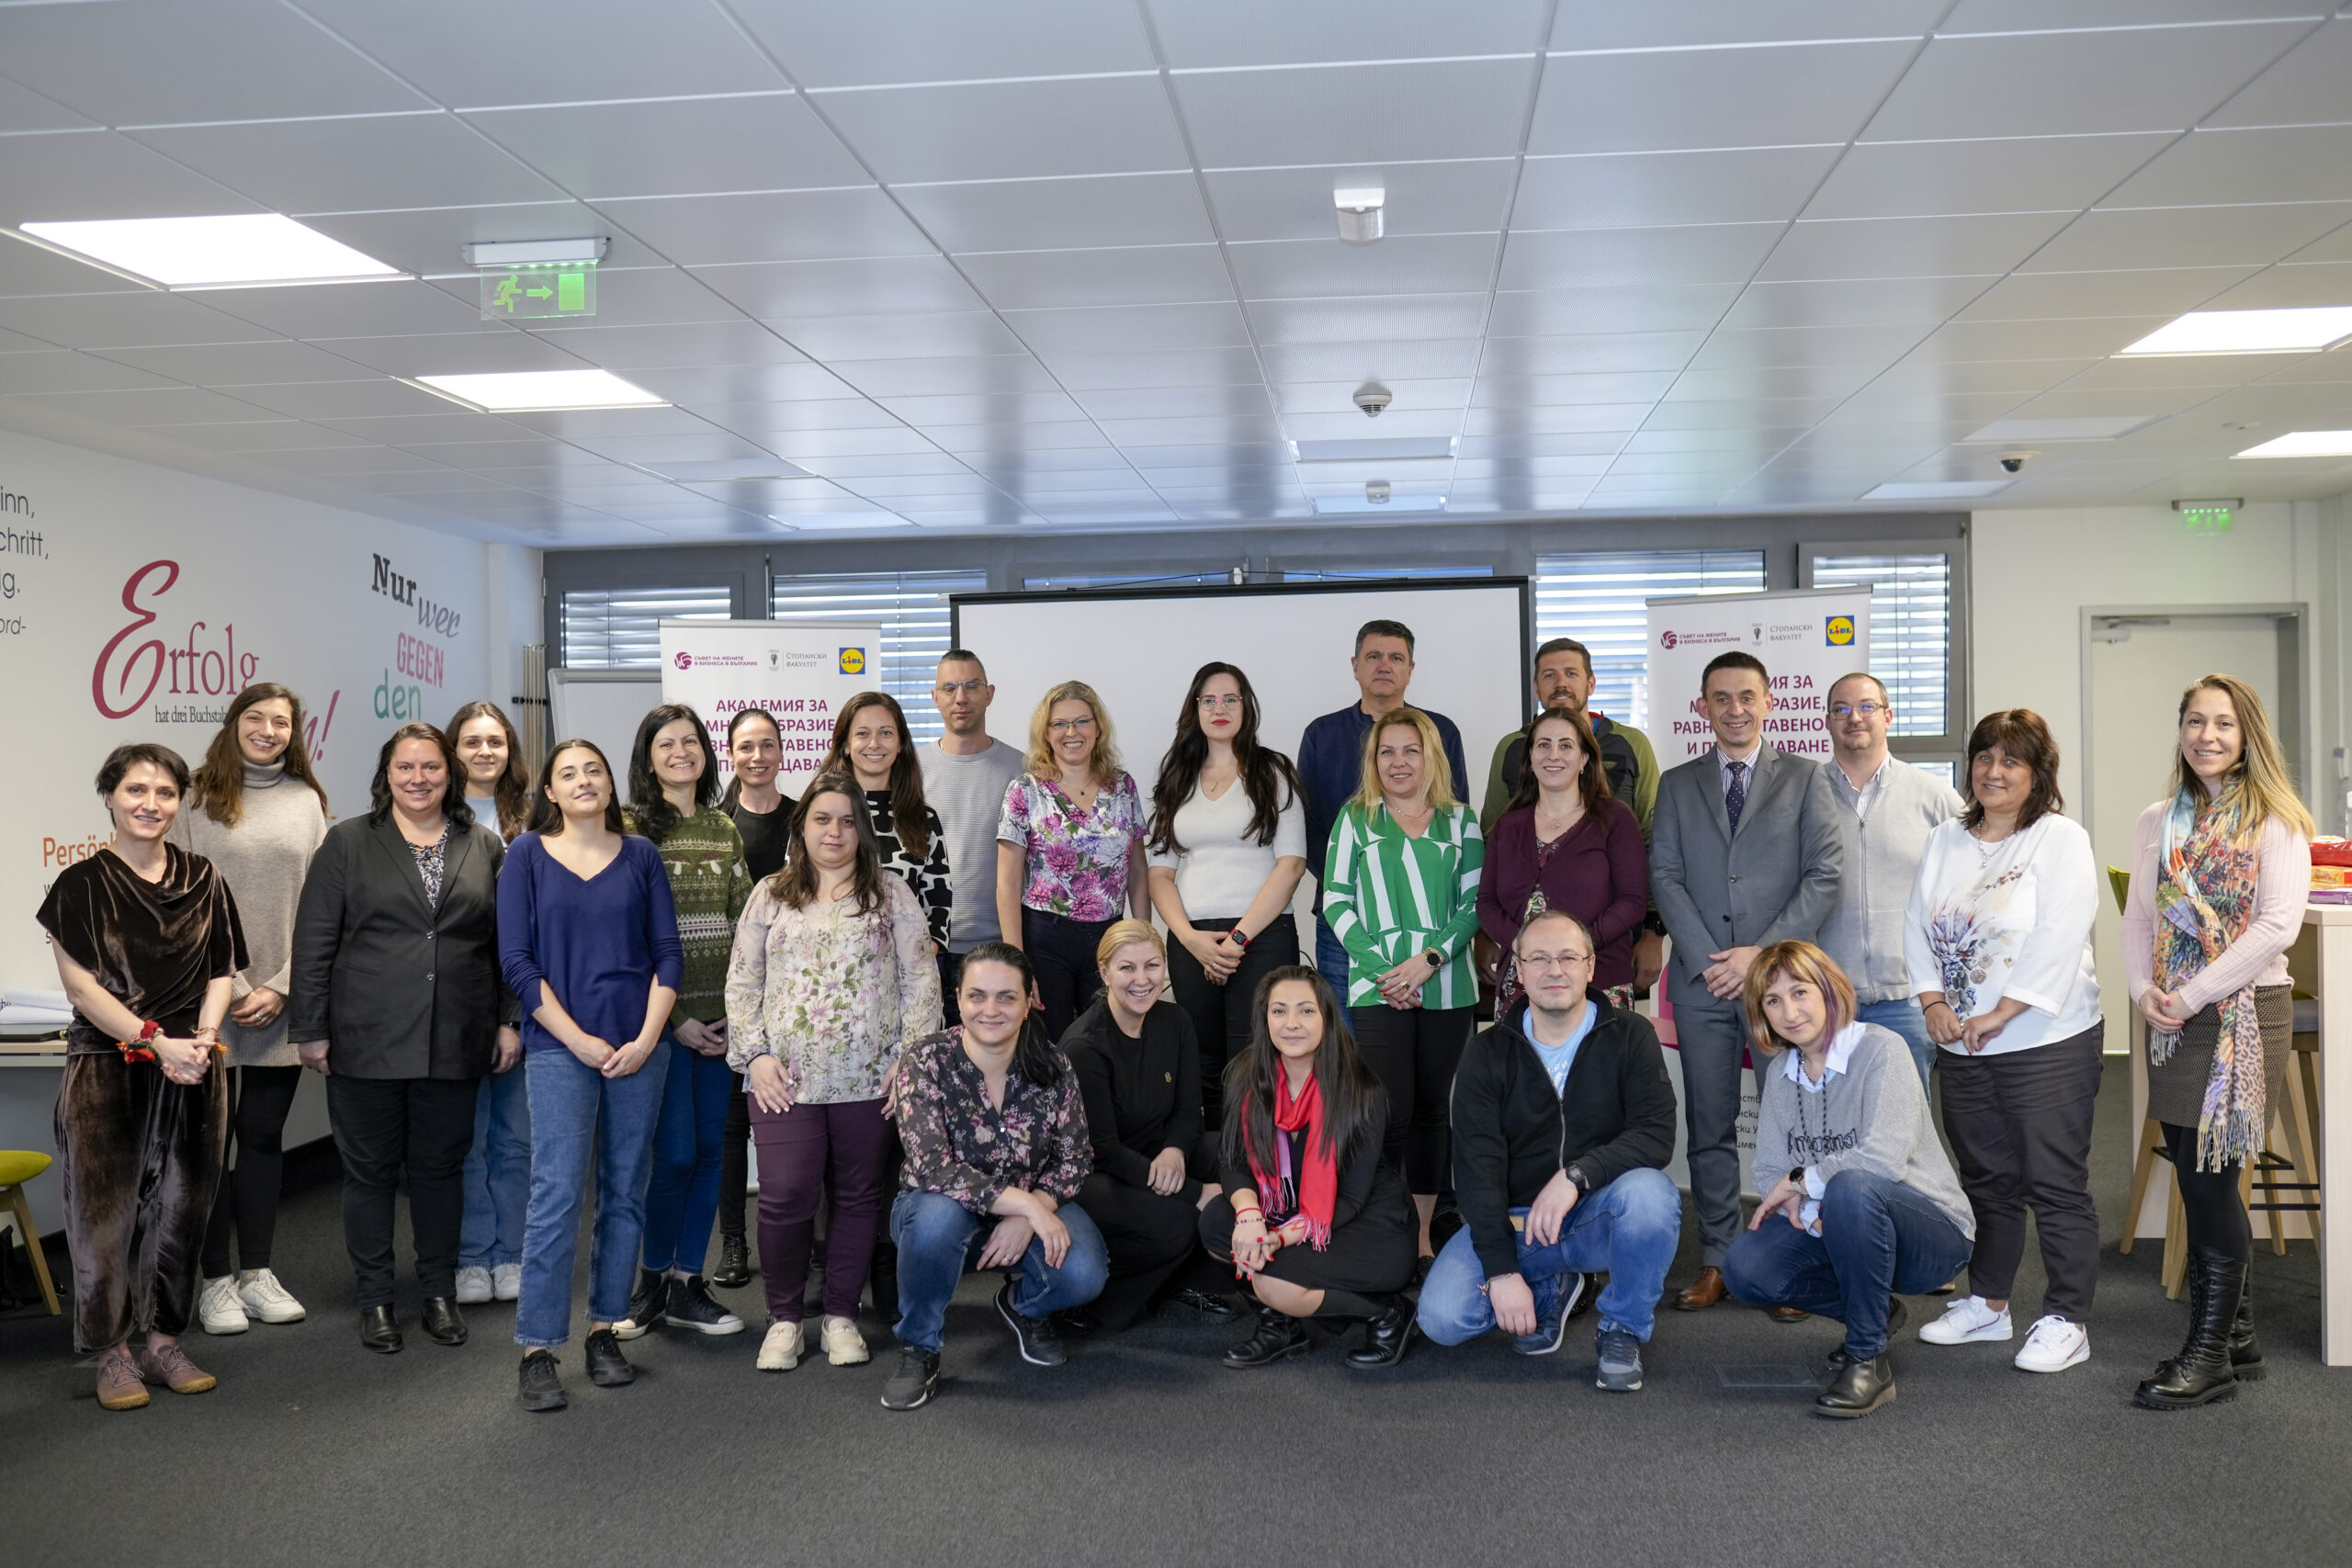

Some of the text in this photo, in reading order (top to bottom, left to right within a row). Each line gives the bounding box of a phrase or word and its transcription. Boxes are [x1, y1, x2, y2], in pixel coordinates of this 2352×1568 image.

[371, 552, 461, 638] Nur wer
[92, 559, 260, 719] Erfolg
[396, 631, 445, 689] GEGEN
[373, 667, 422, 721] den
[1792, 675, 1814, 689] ЗА
[154, 705, 169, 723] hat
[171, 705, 187, 723] drei
[808, 699, 828, 712] ЗА
[1687, 741, 1697, 755] И
